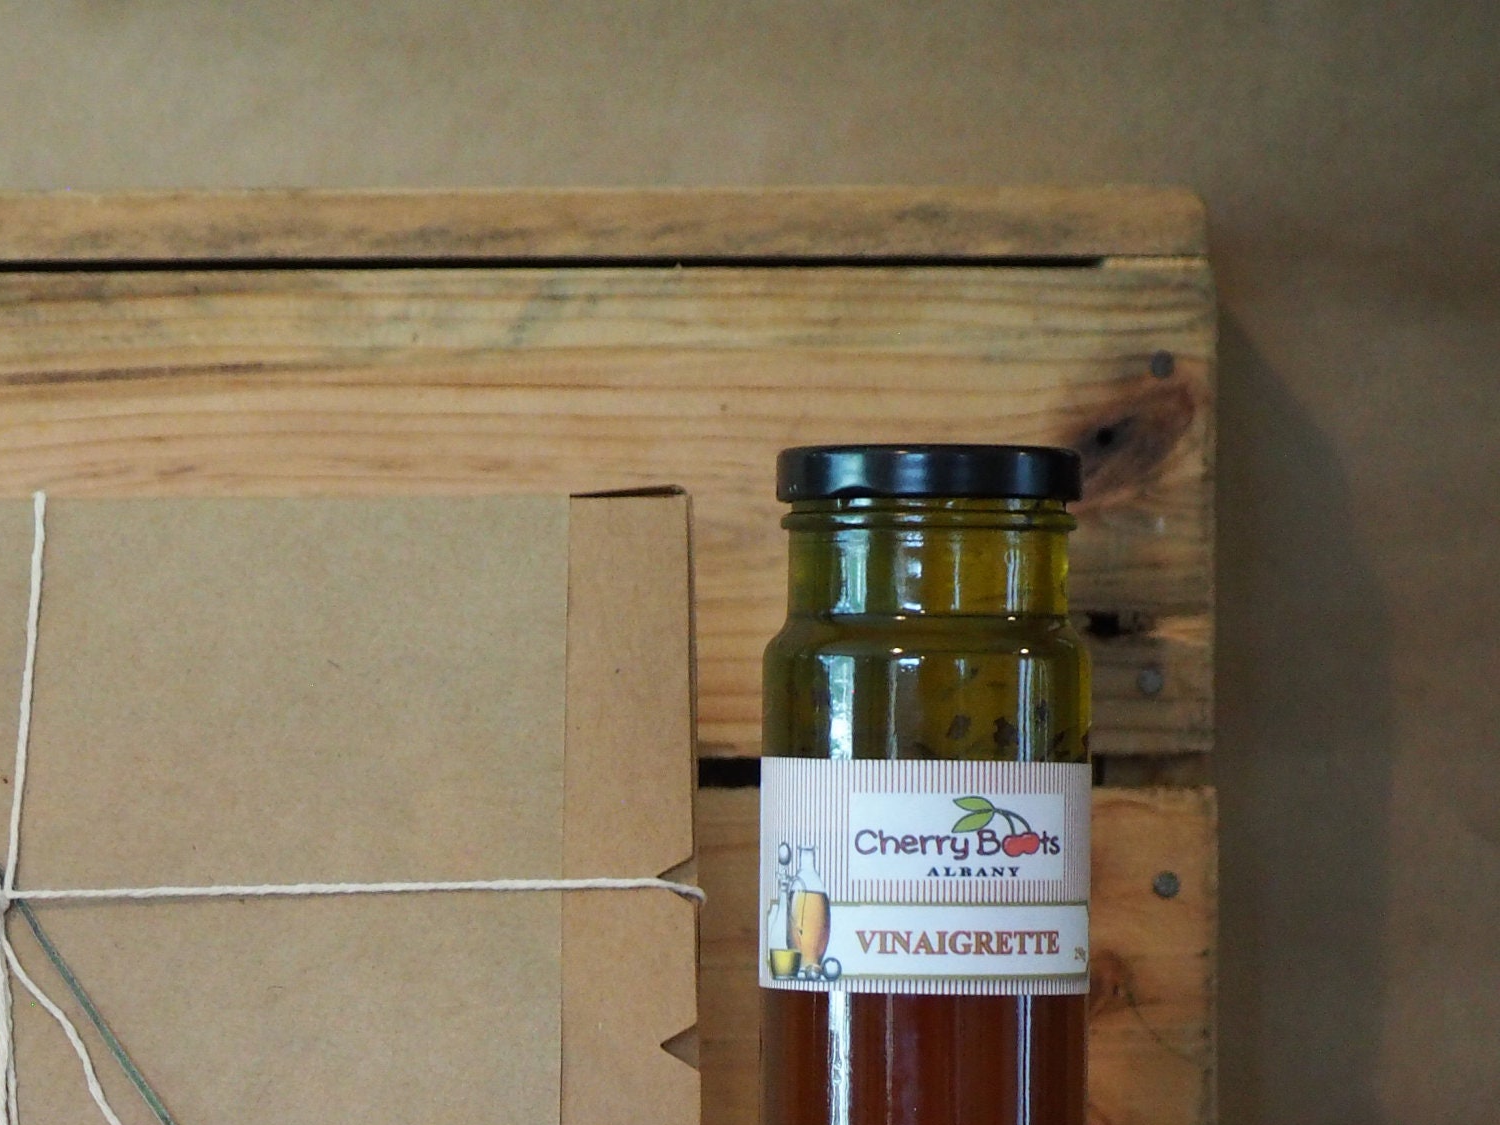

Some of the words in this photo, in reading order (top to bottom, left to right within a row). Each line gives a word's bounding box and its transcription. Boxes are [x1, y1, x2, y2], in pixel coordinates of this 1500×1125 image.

[854, 829, 969, 860] Cherry
[977, 829, 1061, 858] Boots
[926, 866, 1021, 878] ALBANY
[855, 929, 1060, 956] VINAIGRETTE
